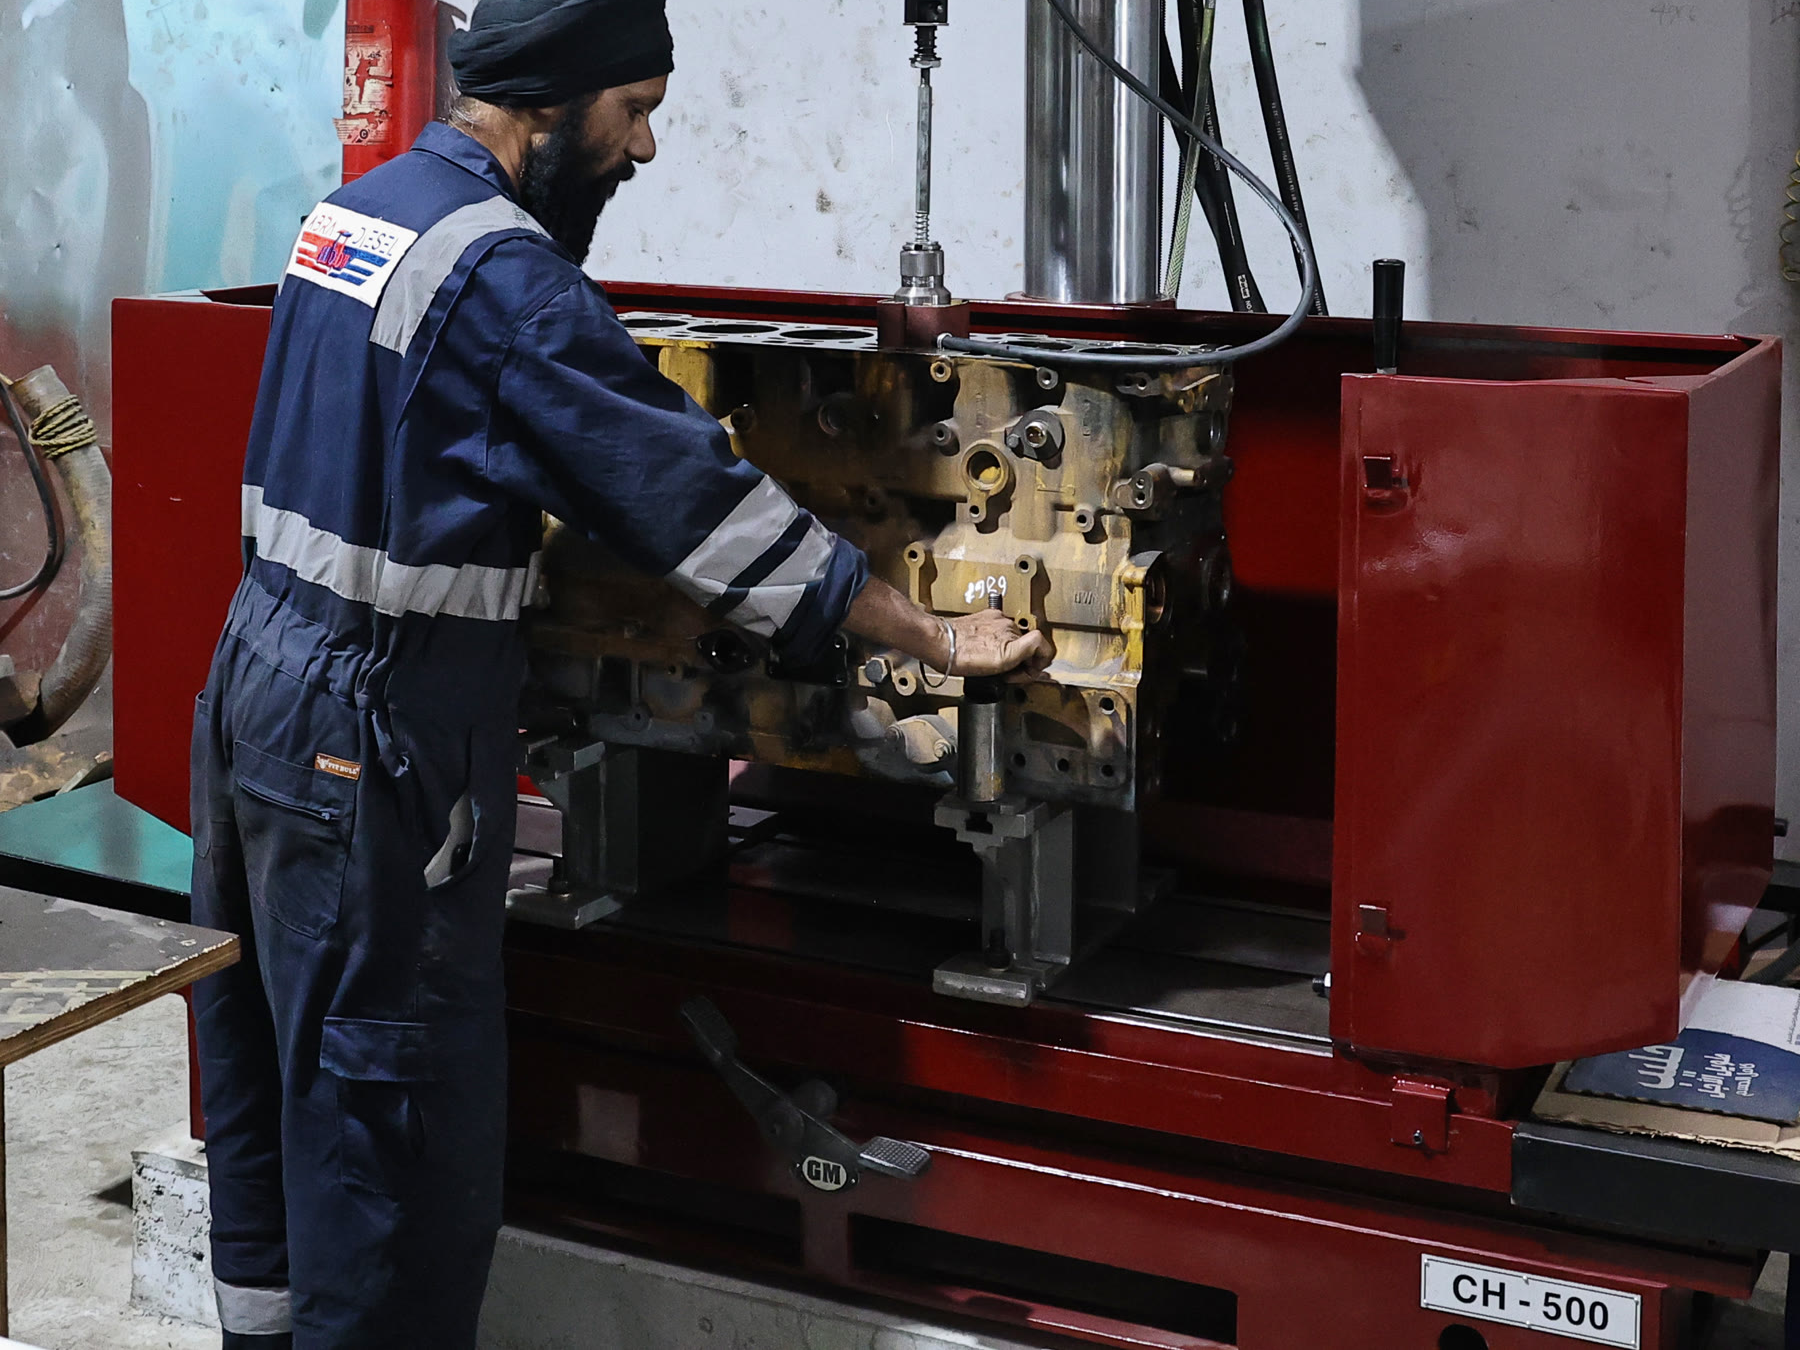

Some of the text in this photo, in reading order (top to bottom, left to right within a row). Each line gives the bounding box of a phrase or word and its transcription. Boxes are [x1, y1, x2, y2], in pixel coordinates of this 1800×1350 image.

[1697, 1053, 1736, 1099] طويل الأجل
[1739, 1063, 1759, 1078] كامل
[807, 1160, 841, 1185] GM
[1452, 1274, 1506, 1310] CH
[1542, 1292, 1609, 1330] 500
